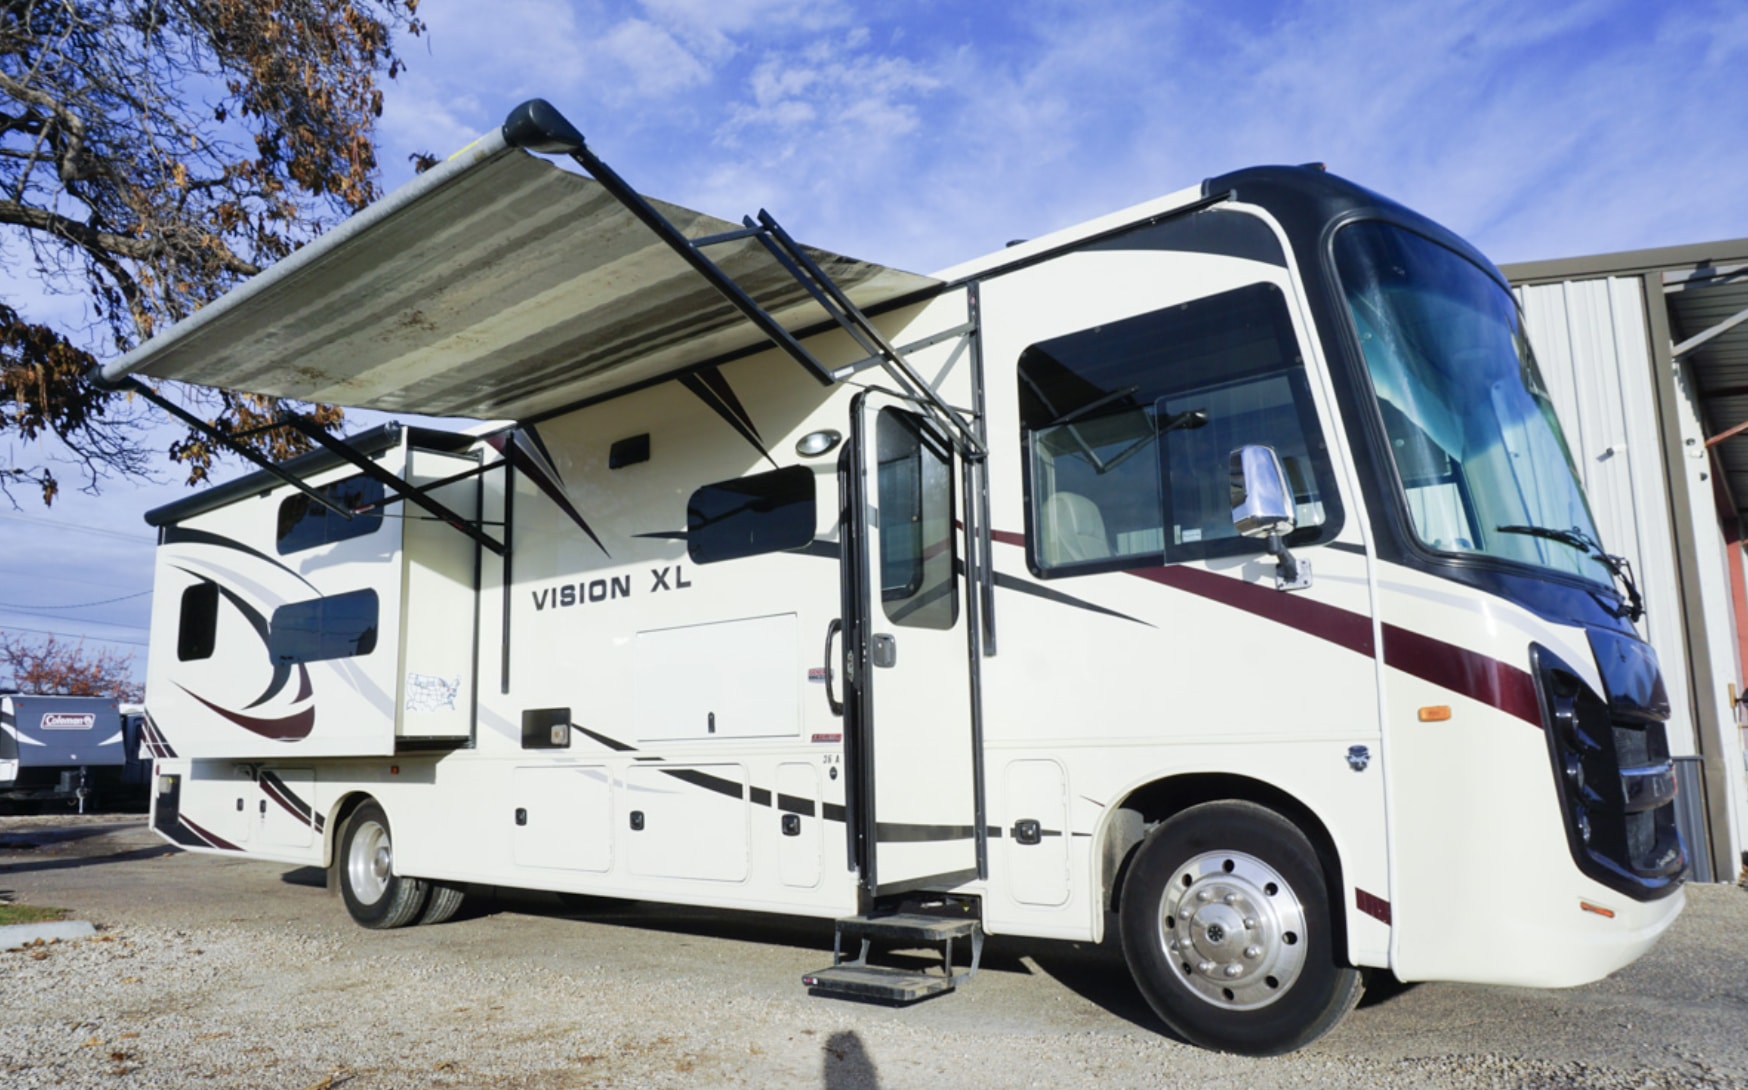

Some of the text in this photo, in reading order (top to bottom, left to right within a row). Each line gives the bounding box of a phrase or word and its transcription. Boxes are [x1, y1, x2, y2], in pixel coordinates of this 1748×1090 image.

[532, 565, 692, 611] VISION XL
[46, 715, 83, 727] Coleman
